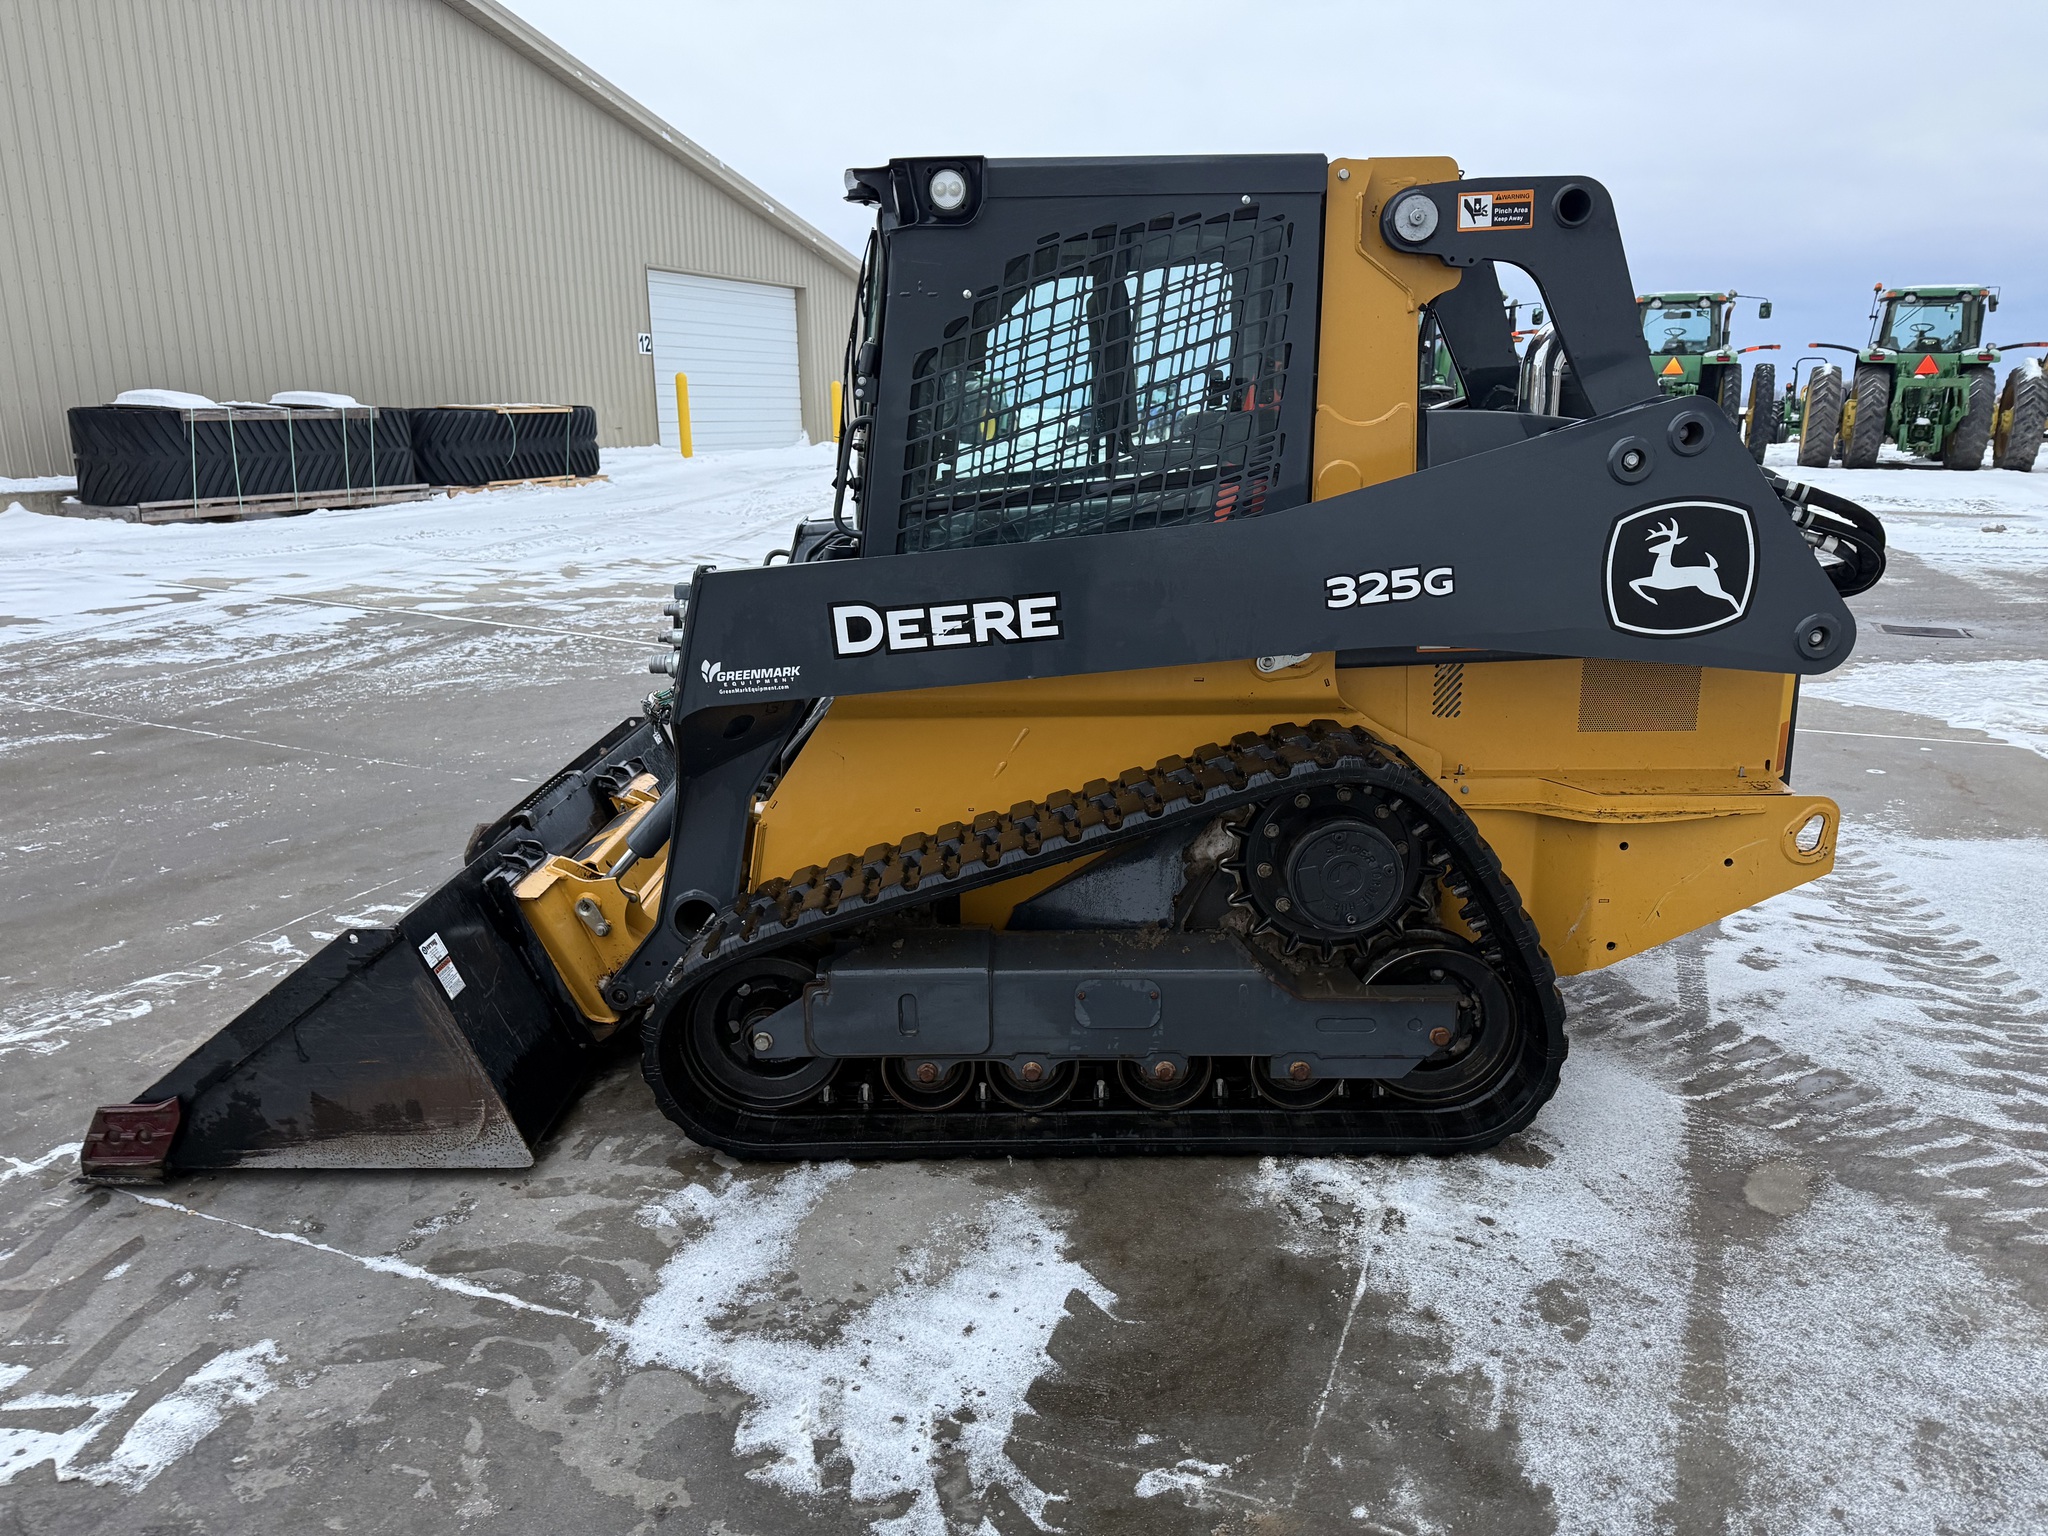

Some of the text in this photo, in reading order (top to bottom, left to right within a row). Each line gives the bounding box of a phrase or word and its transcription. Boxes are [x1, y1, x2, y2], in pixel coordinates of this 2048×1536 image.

[640, 335, 651, 352] 12
[1326, 567, 1453, 608] 325G
[833, 597, 1059, 654] DEERE
[717, 666, 800, 682] GREENMARK
[724, 677, 794, 687] EQUIPMENT
[719, 685, 789, 694] GreenMarkEquipment.com
